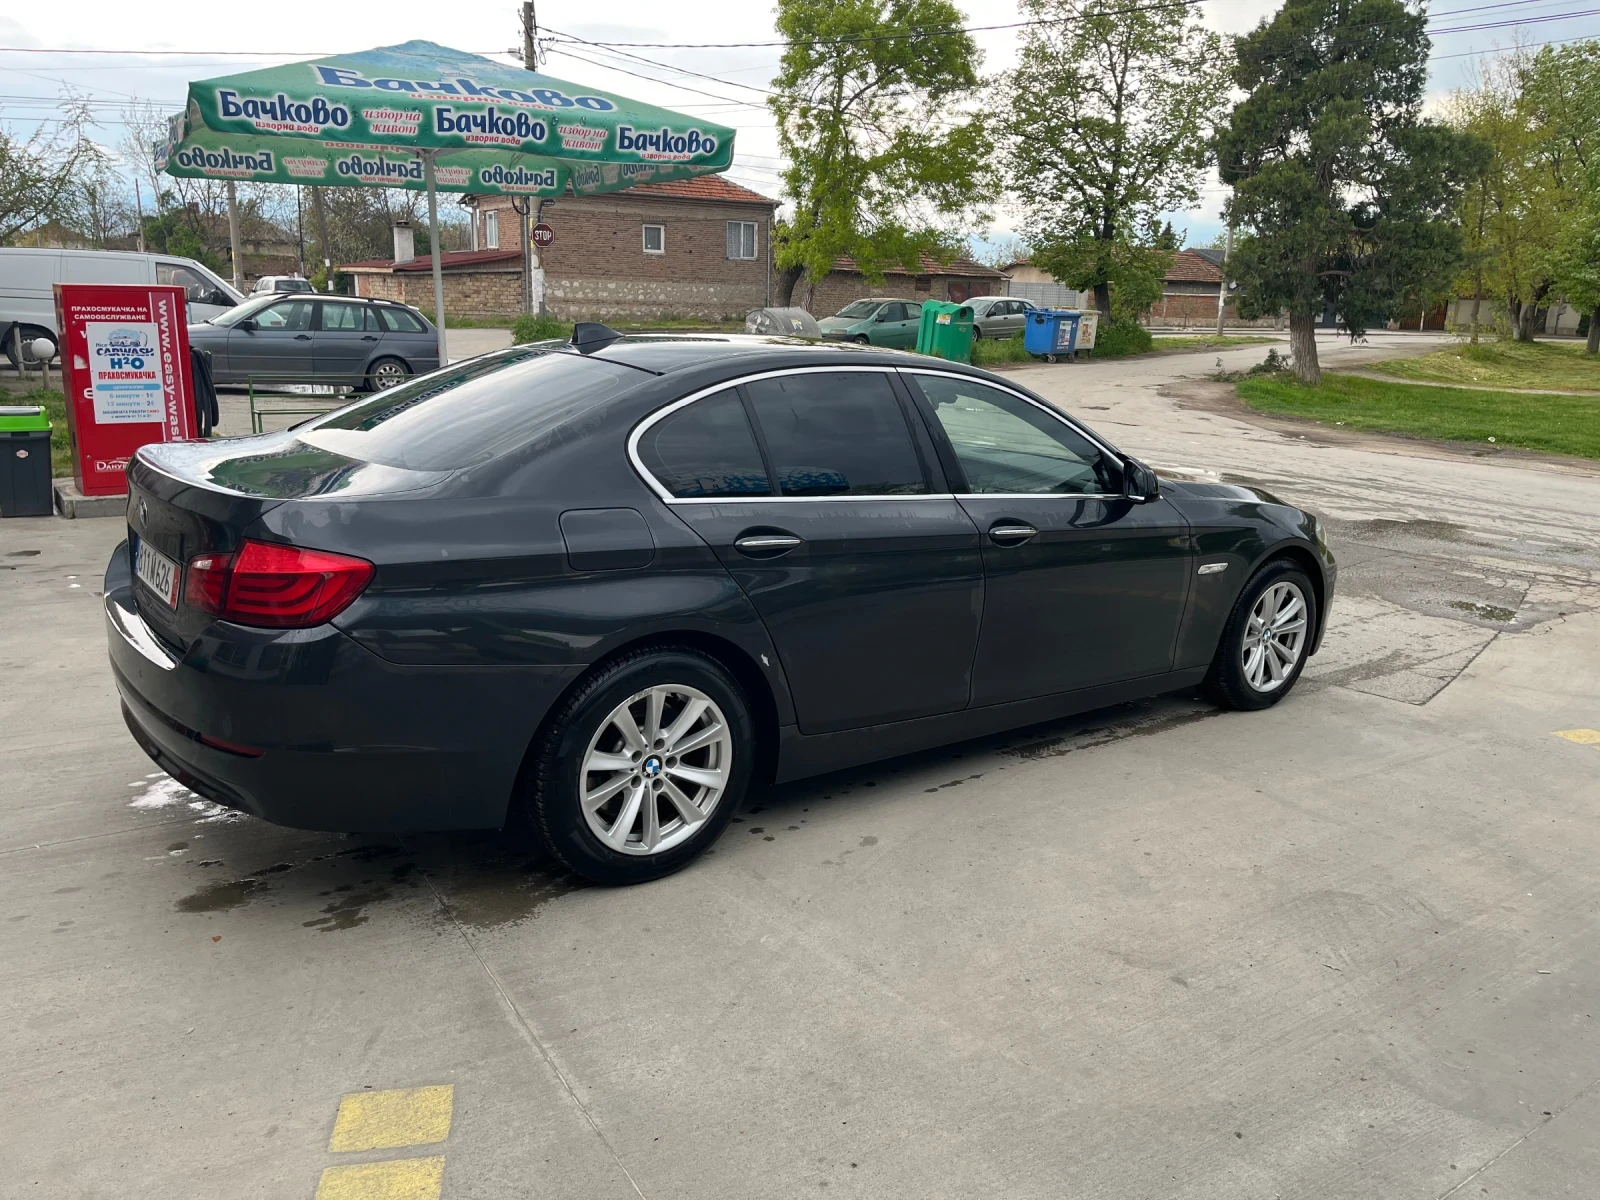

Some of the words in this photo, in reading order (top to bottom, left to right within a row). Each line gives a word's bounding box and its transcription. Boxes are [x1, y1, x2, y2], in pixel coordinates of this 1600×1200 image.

[316, 65, 614, 111] Бачково
[219, 90, 348, 127] Бачково
[362, 108, 403, 122] избор
[405, 113, 421, 121] на
[255, 121, 294, 131] изворна
[371, 123, 417, 134] живот
[436, 106, 546, 140] Бачково
[558, 123, 591, 137] избор
[593, 129, 607, 138] на
[465, 134, 499, 144] изворна
[501, 137, 521, 146] вода
[562, 138, 602, 150] живот
[618, 126, 716, 154] Бачково
[641, 152, 671, 161] изворна
[534, 230, 552, 241] STOP
[71, 305, 136, 313] ПРАХОСМУКАЧКА
[74, 313, 147, 321] САМООБСЛУЖВАНЕ
[96, 347, 155, 357] CARWASH
[98, 371, 157, 380] ПРАХОСМУКАЧКА
